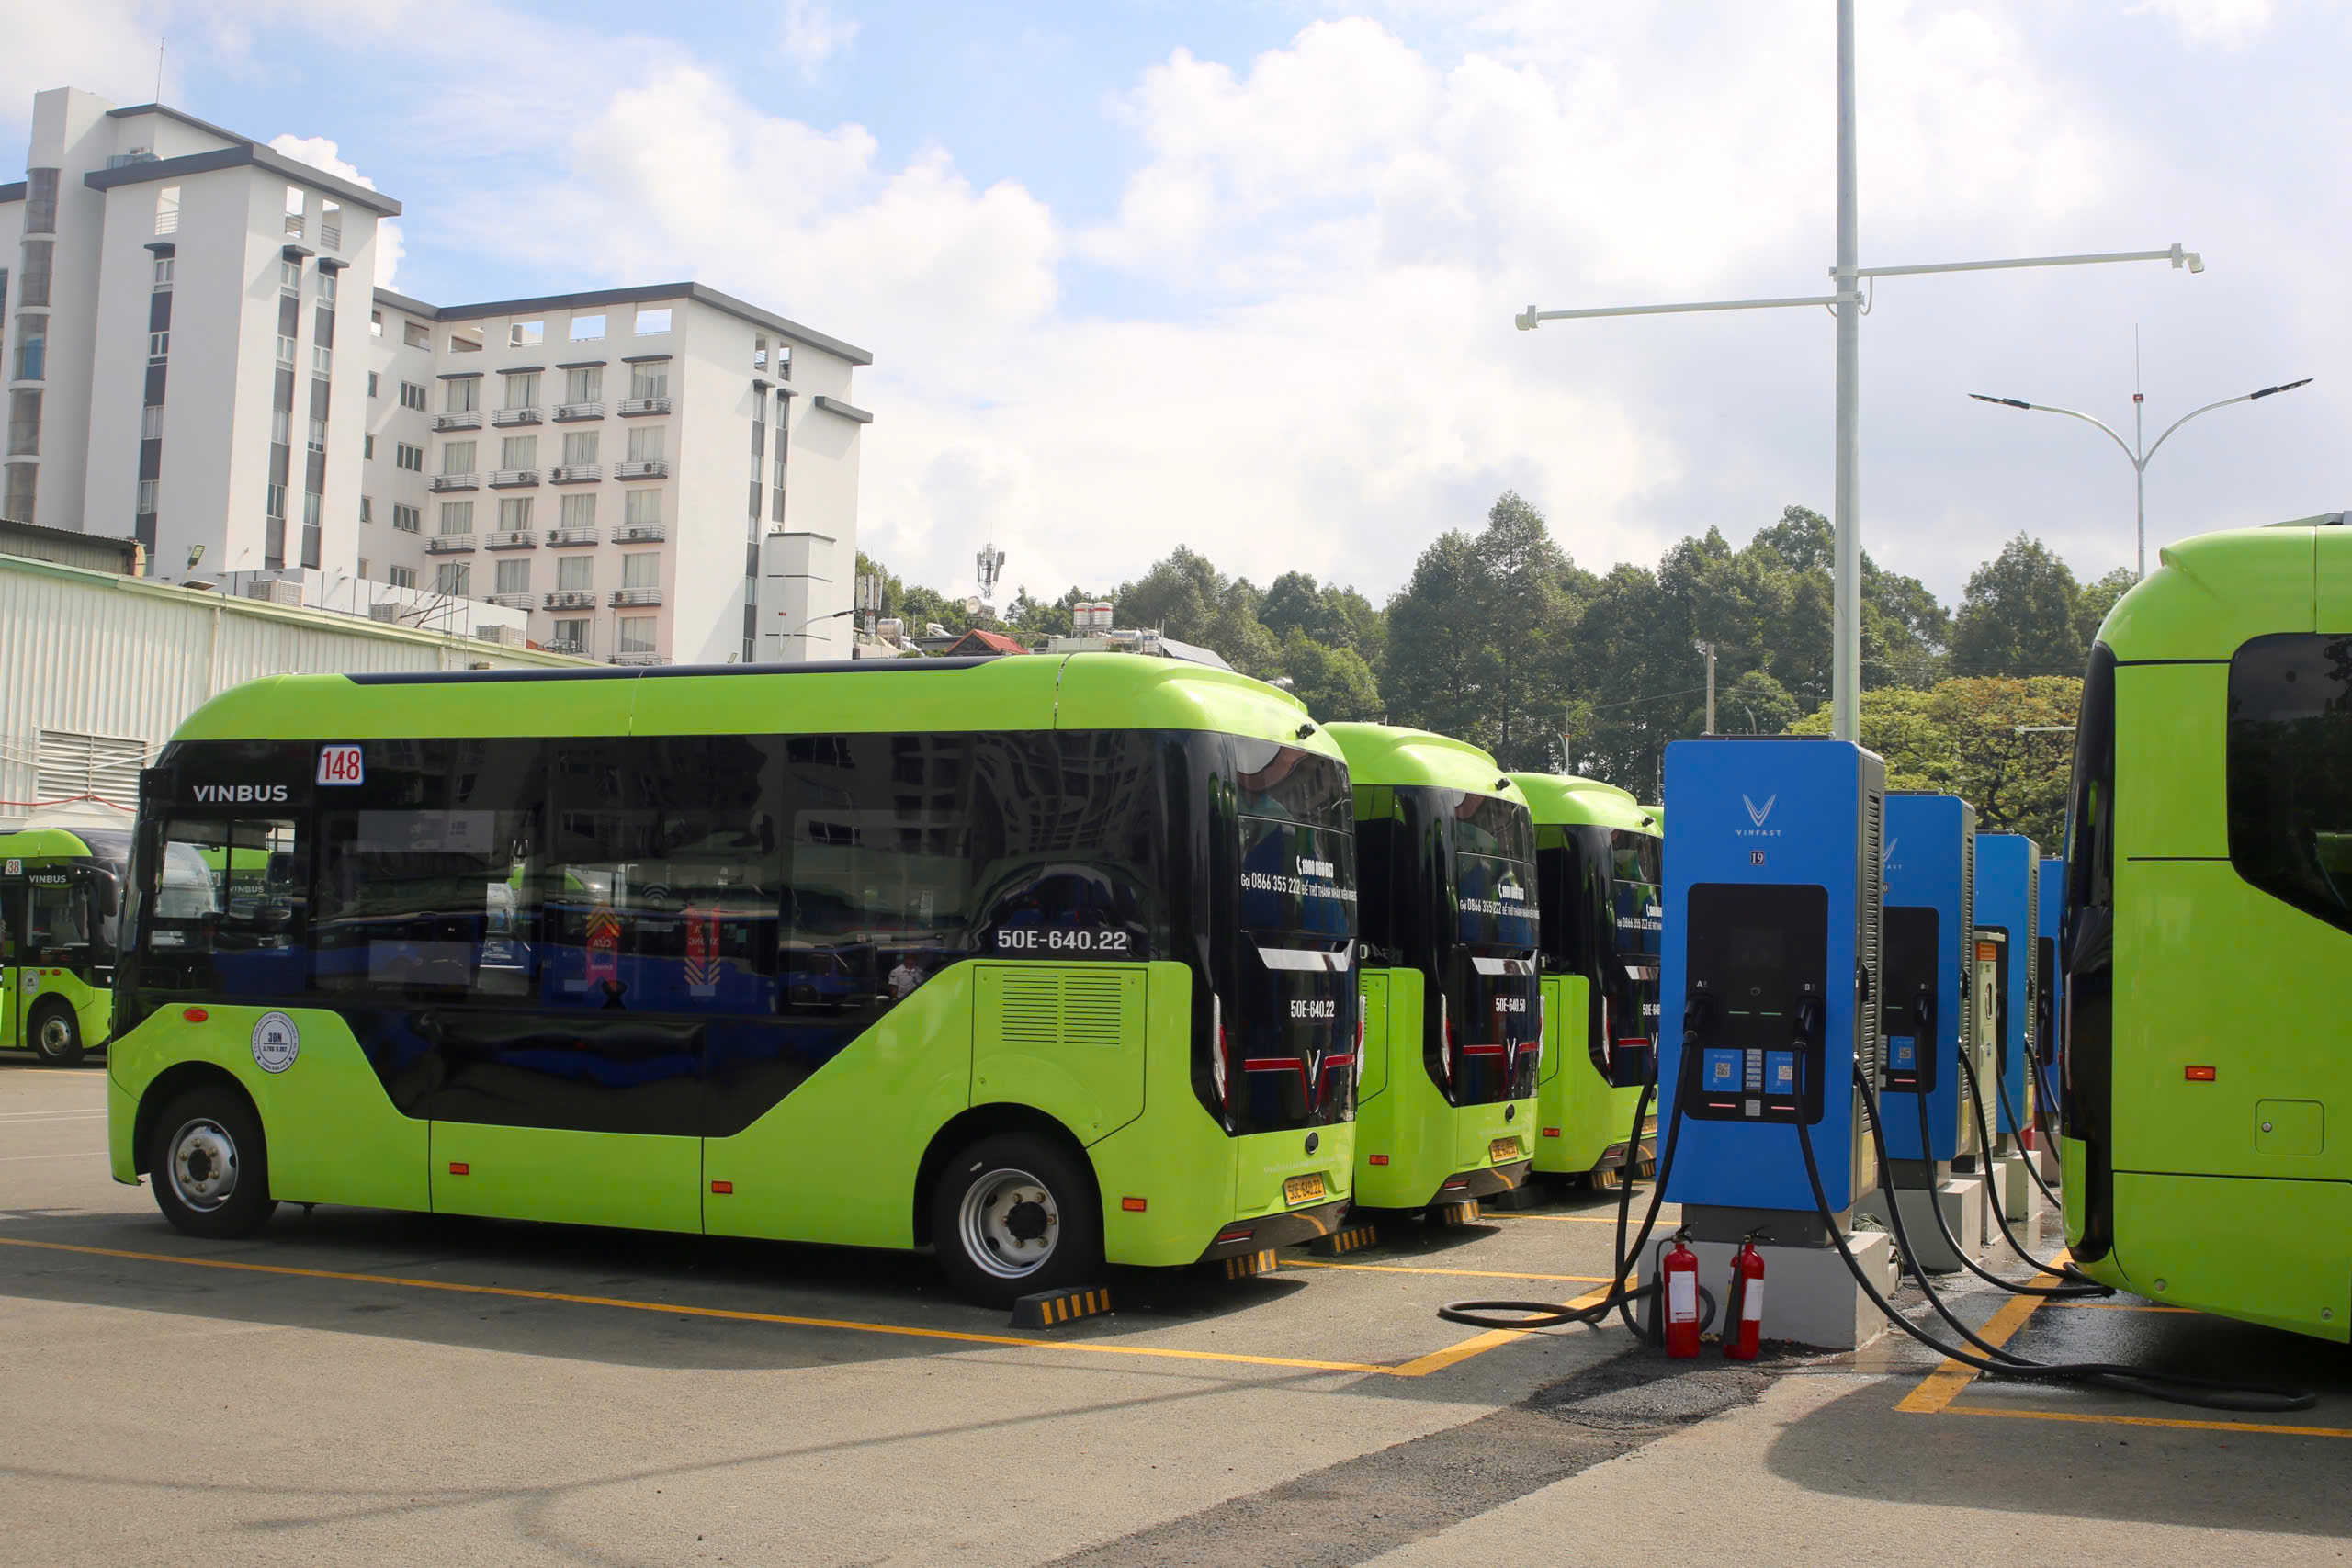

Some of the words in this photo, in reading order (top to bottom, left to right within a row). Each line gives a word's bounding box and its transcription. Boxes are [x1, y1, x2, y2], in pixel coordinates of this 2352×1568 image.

[322, 750, 360, 780] 148
[192, 785, 288, 802] VINBUS
[1752, 852, 1764, 864] 19
[7, 861, 20, 874] 38
[1240, 873, 1250, 891] Gọi
[1251, 872, 1272, 890] 0866
[1272, 874, 1287, 893] 355
[1288, 877, 1301, 895] 222
[1467, 898, 1482, 912] 0866
[1482, 900, 1493, 913] 355
[1493, 901, 1502, 915] 222
[998, 930, 1127, 950] 50E-640.22
[1696, 980, 1703, 988] A
[1804, 983, 1811, 991] B
[1290, 999, 1335, 1018] 50E-640.22
[1495, 998, 1526, 1012] 50E-640.50
[267, 1032, 282, 1043] 30N
[1288, 1179, 1322, 1200] 50E-640.22
